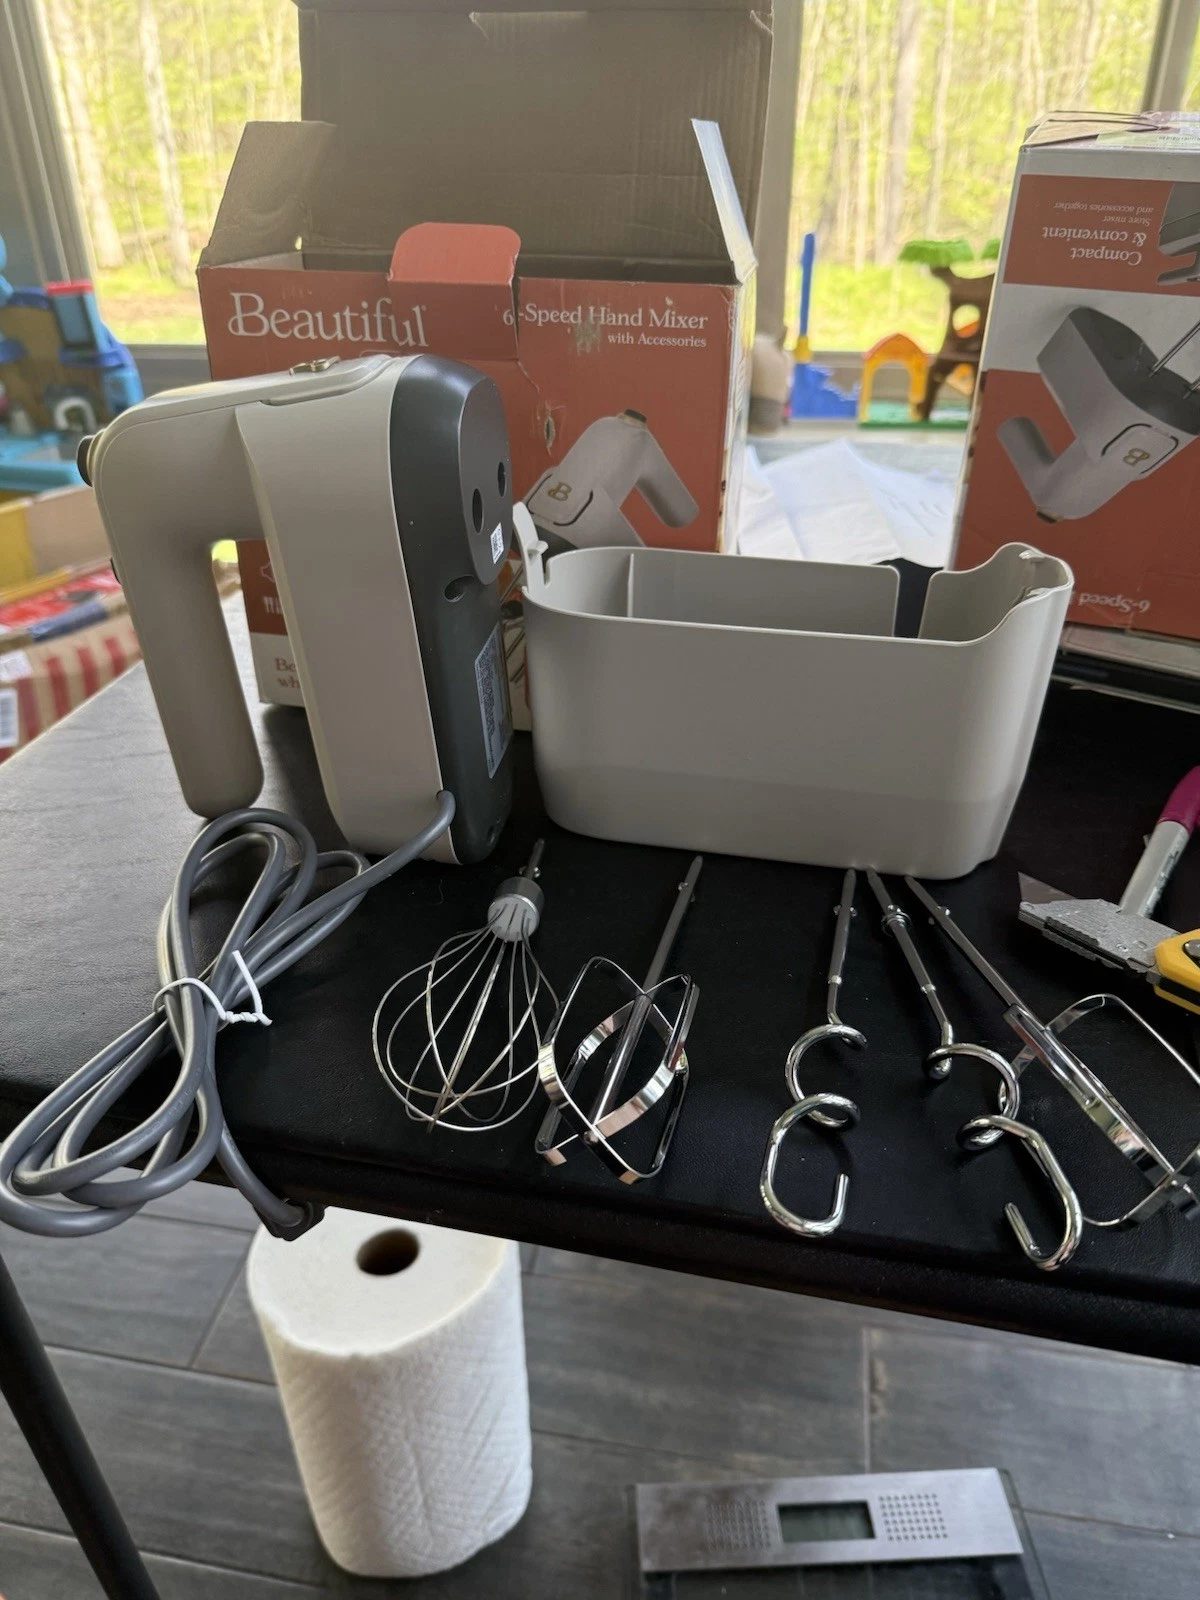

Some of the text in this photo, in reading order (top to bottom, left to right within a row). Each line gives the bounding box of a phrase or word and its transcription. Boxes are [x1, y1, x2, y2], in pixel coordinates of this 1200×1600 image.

[1054, 200, 1154, 215] and accessories together
[1103, 215, 1152, 227] Store mixer
[1042, 226, 1147, 247] & convenient
[1070, 246, 1143, 266] Compact
[228, 292, 429, 347] Beautiful
[503, 303, 708, 330] 6-Speed Hand Mixer
[607, 332, 707, 348] with Accessories
[1078, 592, 1151, 613] 6-Speed
